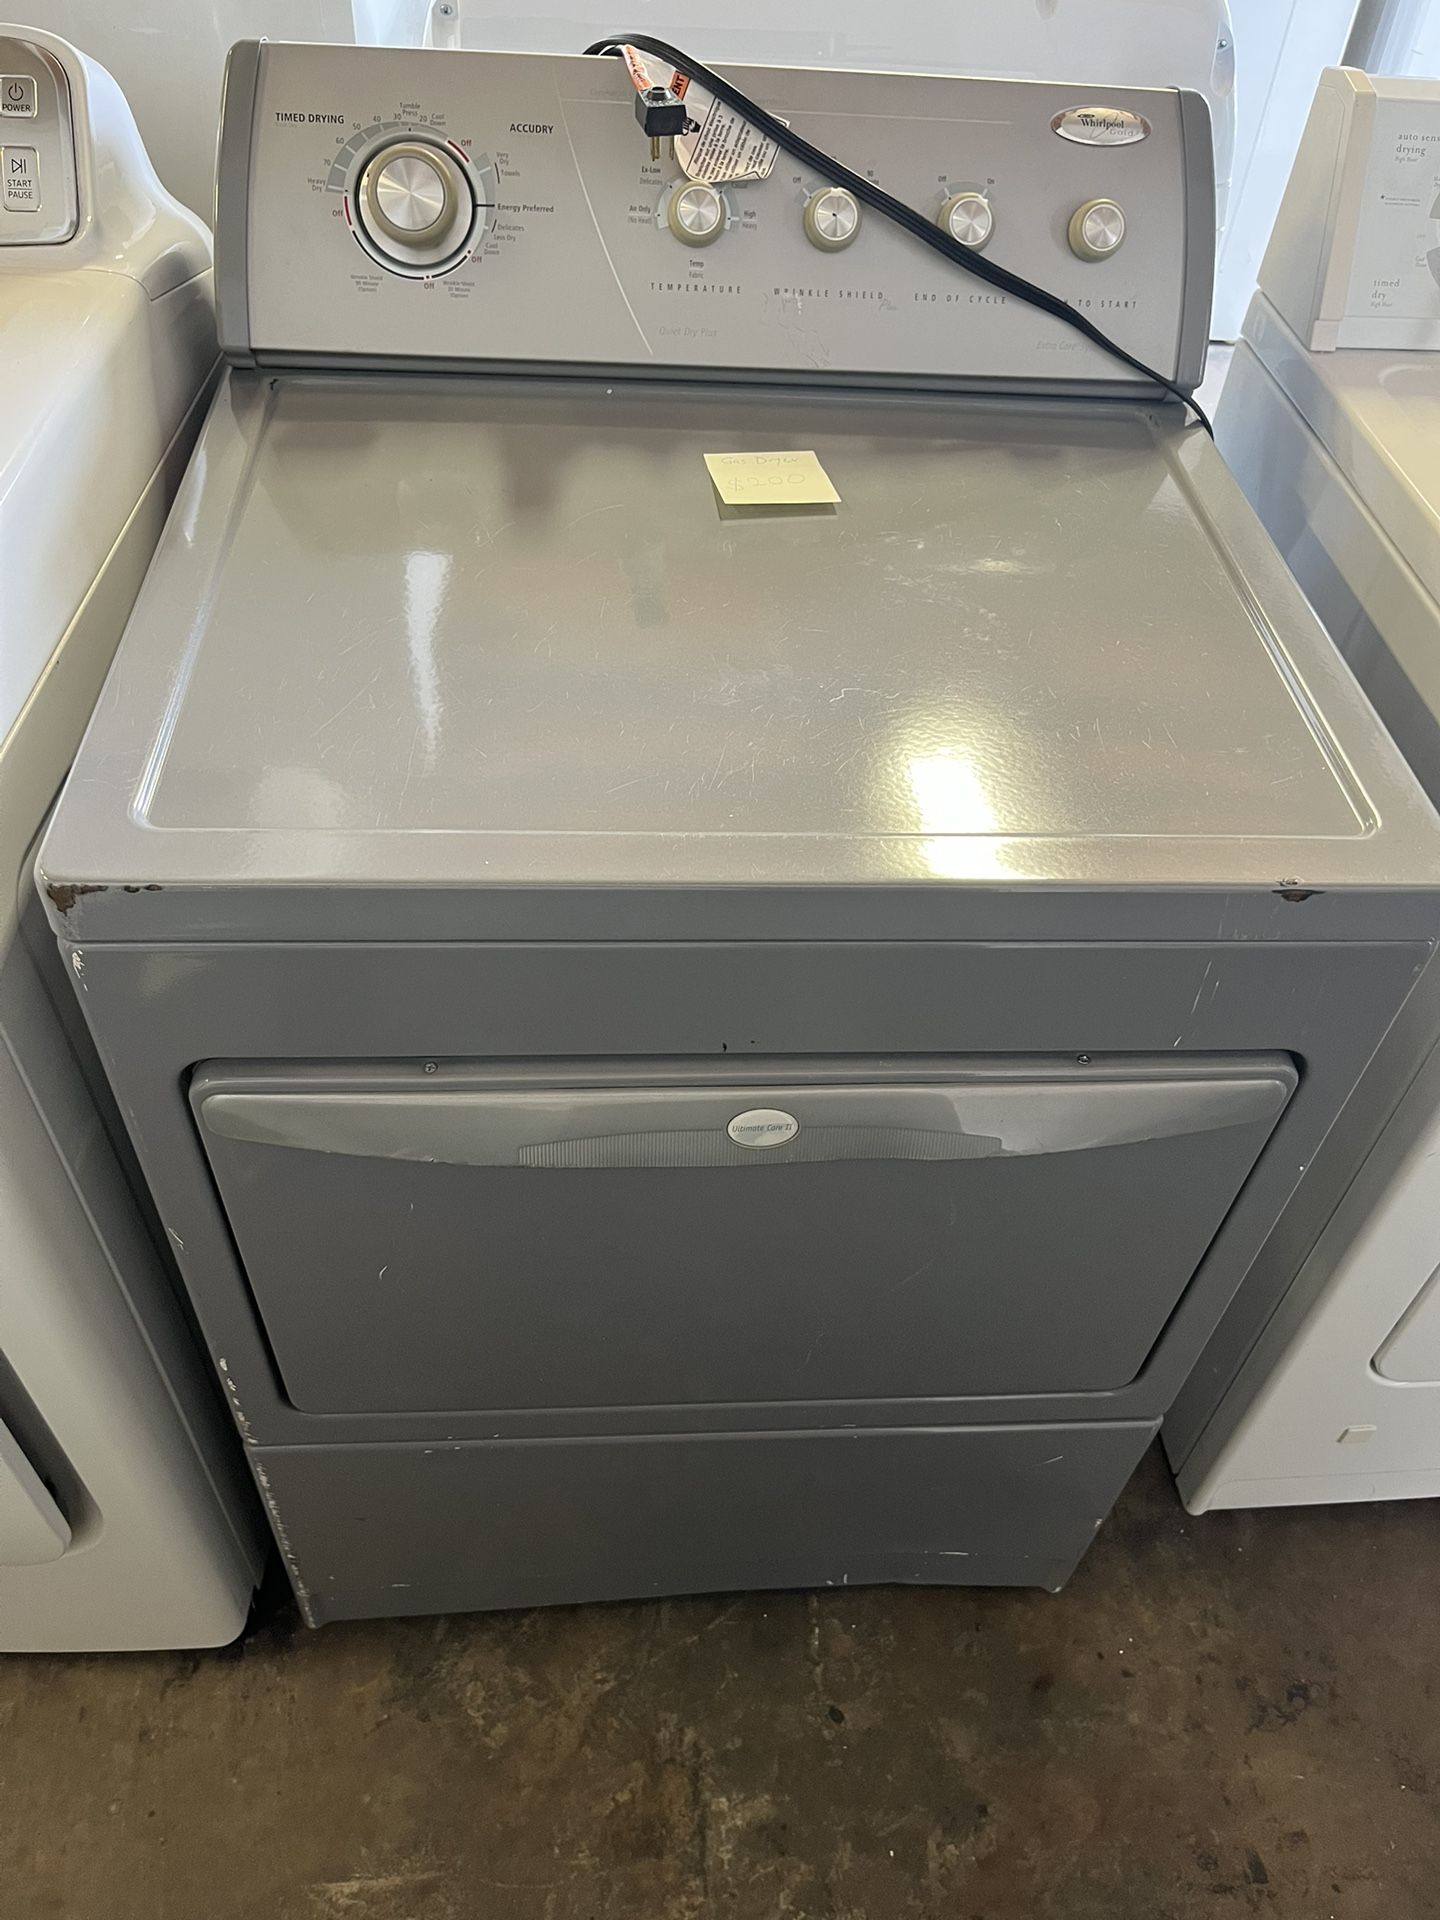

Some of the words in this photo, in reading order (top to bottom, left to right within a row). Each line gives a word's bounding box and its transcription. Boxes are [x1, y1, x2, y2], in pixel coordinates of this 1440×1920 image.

[2, 104, 31, 112] POWER
[275, 113, 306, 122] TIMED
[308, 114, 345, 124] DRYING
[510, 123, 554, 134] ACCUDRY
[1081, 118, 1124, 130] Whirlpool
[1396, 144, 1427, 157] drying
[323, 158, 331, 166] 70
[7, 180, 32, 188] START
[7, 191, 33, 199] PAUSE
[497, 203, 520, 212] Energy
[522, 204, 554, 212] Preferred
[424, 282, 434, 290] Off
[1373, 278, 1400, 288] timed
[651, 283, 741, 294] TEMPERATURE
[839, 290, 884, 300] SHIELD
[914, 293, 937, 302] END
[946, 294, 959, 302] OF
[969, 295, 1007, 304] CYCLE
[1371, 290, 1386, 300] dry
[1078, 299, 1092, 308] TO
[1101, 300, 1138, 309] START
[727, 473, 806, 492] $200
[732, 1124, 765, 1133] Ultimate
[766, 1124, 783, 1132] Care
[785, 1123, 793, 1131] II
